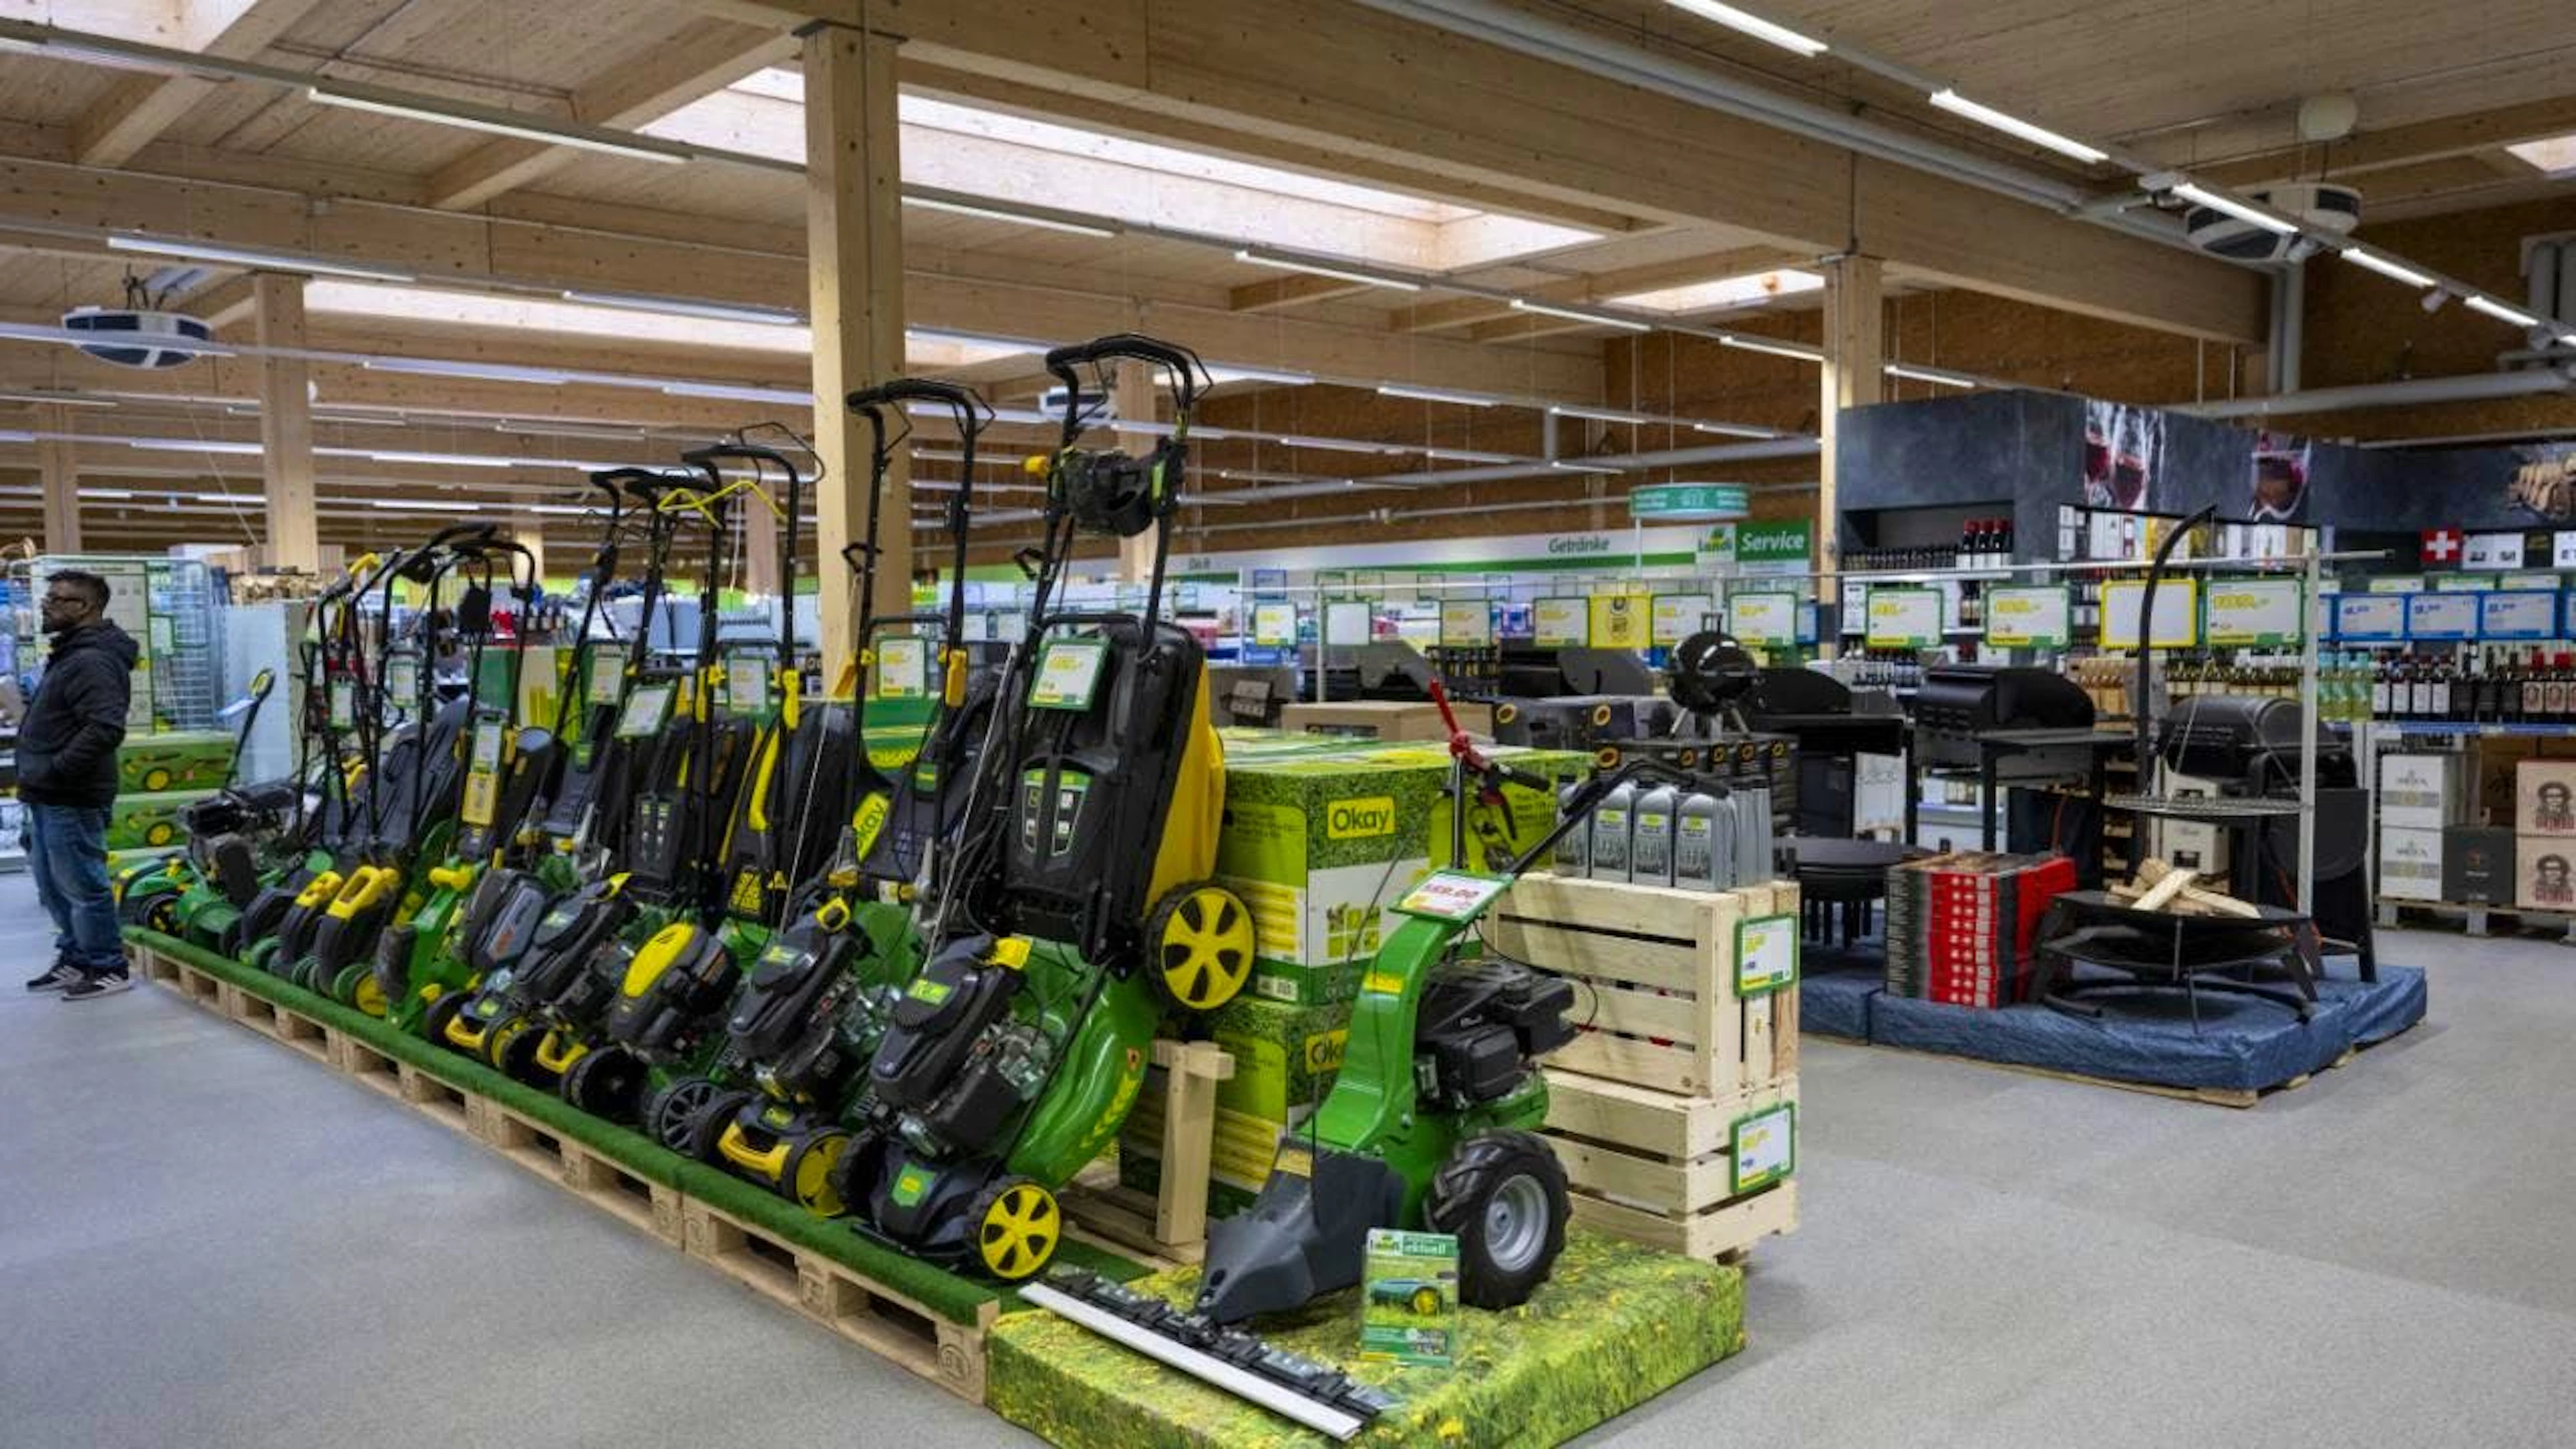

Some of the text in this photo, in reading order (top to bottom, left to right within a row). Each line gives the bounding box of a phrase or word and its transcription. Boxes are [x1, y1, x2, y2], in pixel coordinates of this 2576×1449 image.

[1548, 537, 1610, 553] Getränke
[1741, 531, 1805, 551] Service
[1332, 806, 1391, 833] Okay
[1312, 1039, 1344, 1065] Ok
